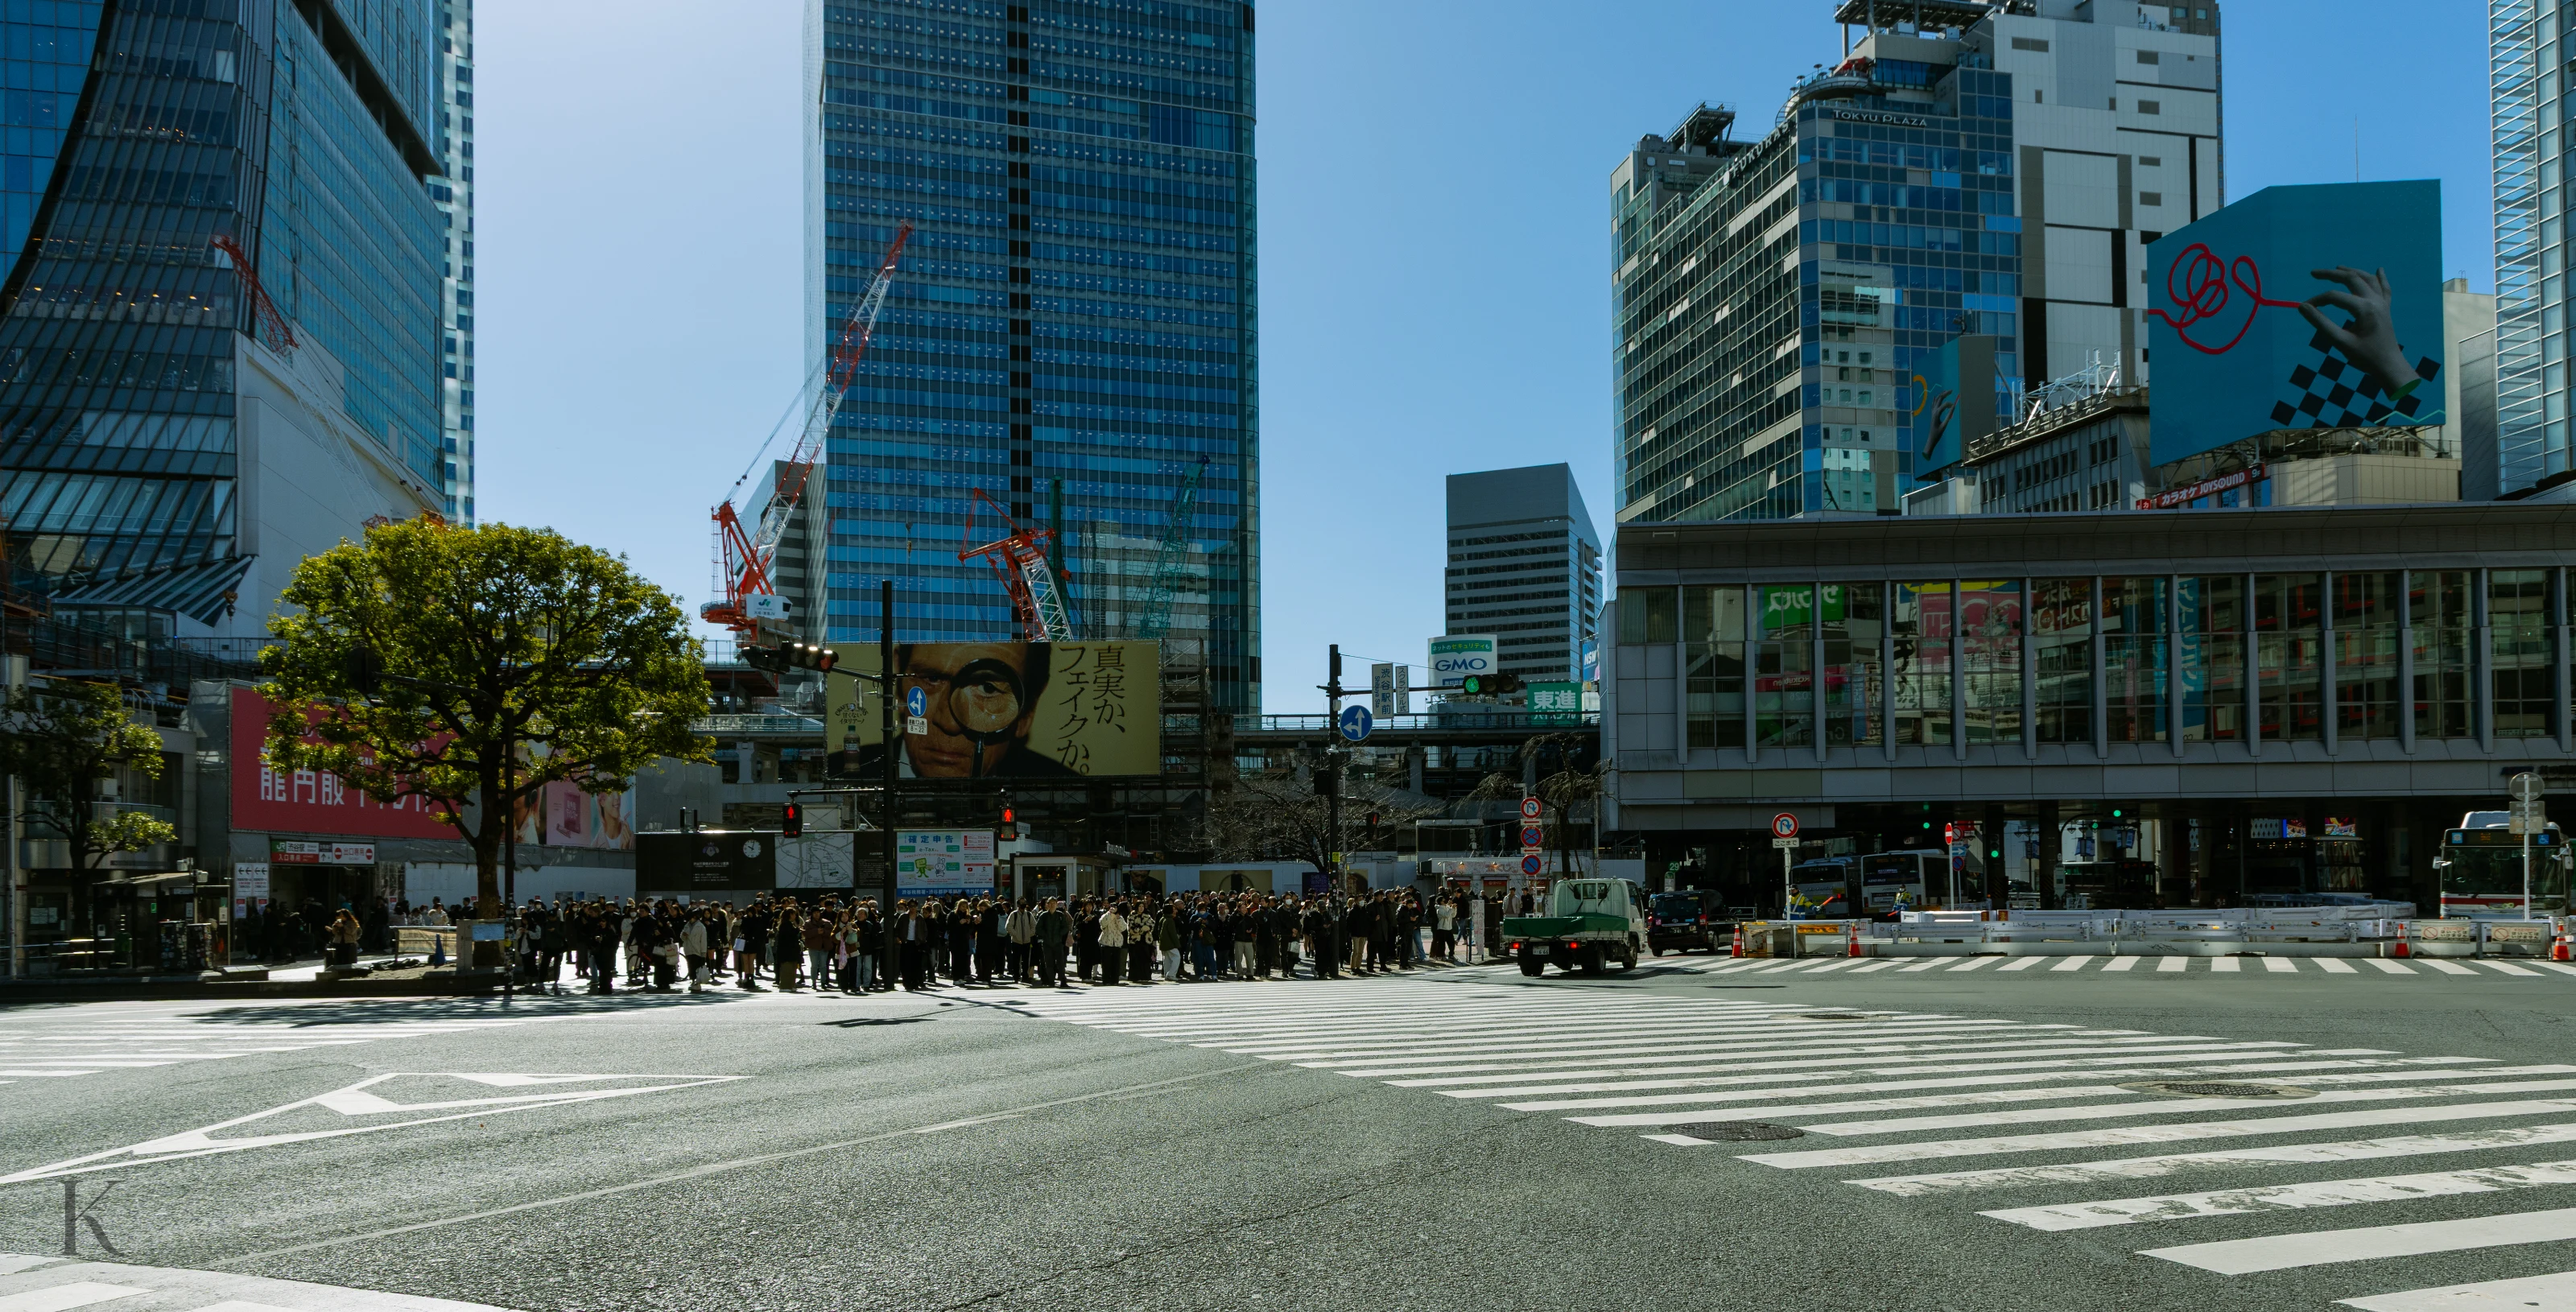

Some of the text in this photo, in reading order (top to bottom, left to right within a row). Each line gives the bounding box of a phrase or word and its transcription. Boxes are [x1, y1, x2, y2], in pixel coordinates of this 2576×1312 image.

[1833, 109, 1927, 126] TOKYU PLAZA
[1732, 122, 1789, 178] FUKURAS
[2161, 468, 2261, 505] カラオケ JOYSOUND 9F
[1432, 642, 1490, 652] ネットのセキュリティも
[1435, 658, 1488, 671] GMO
[1583, 650, 1598, 666] NSW
[1092, 645, 1125, 733] 真実か、
[1381, 667, 1391, 715] 渋谷駅前
[1397, 667, 1407, 712] スクランブル式
[1057, 646, 1090, 774] フェイクか。
[1533, 690, 1576, 710] 東進
[908, 835, 954, 844] 確定申告
[1669, 862, 1679, 871] 29
